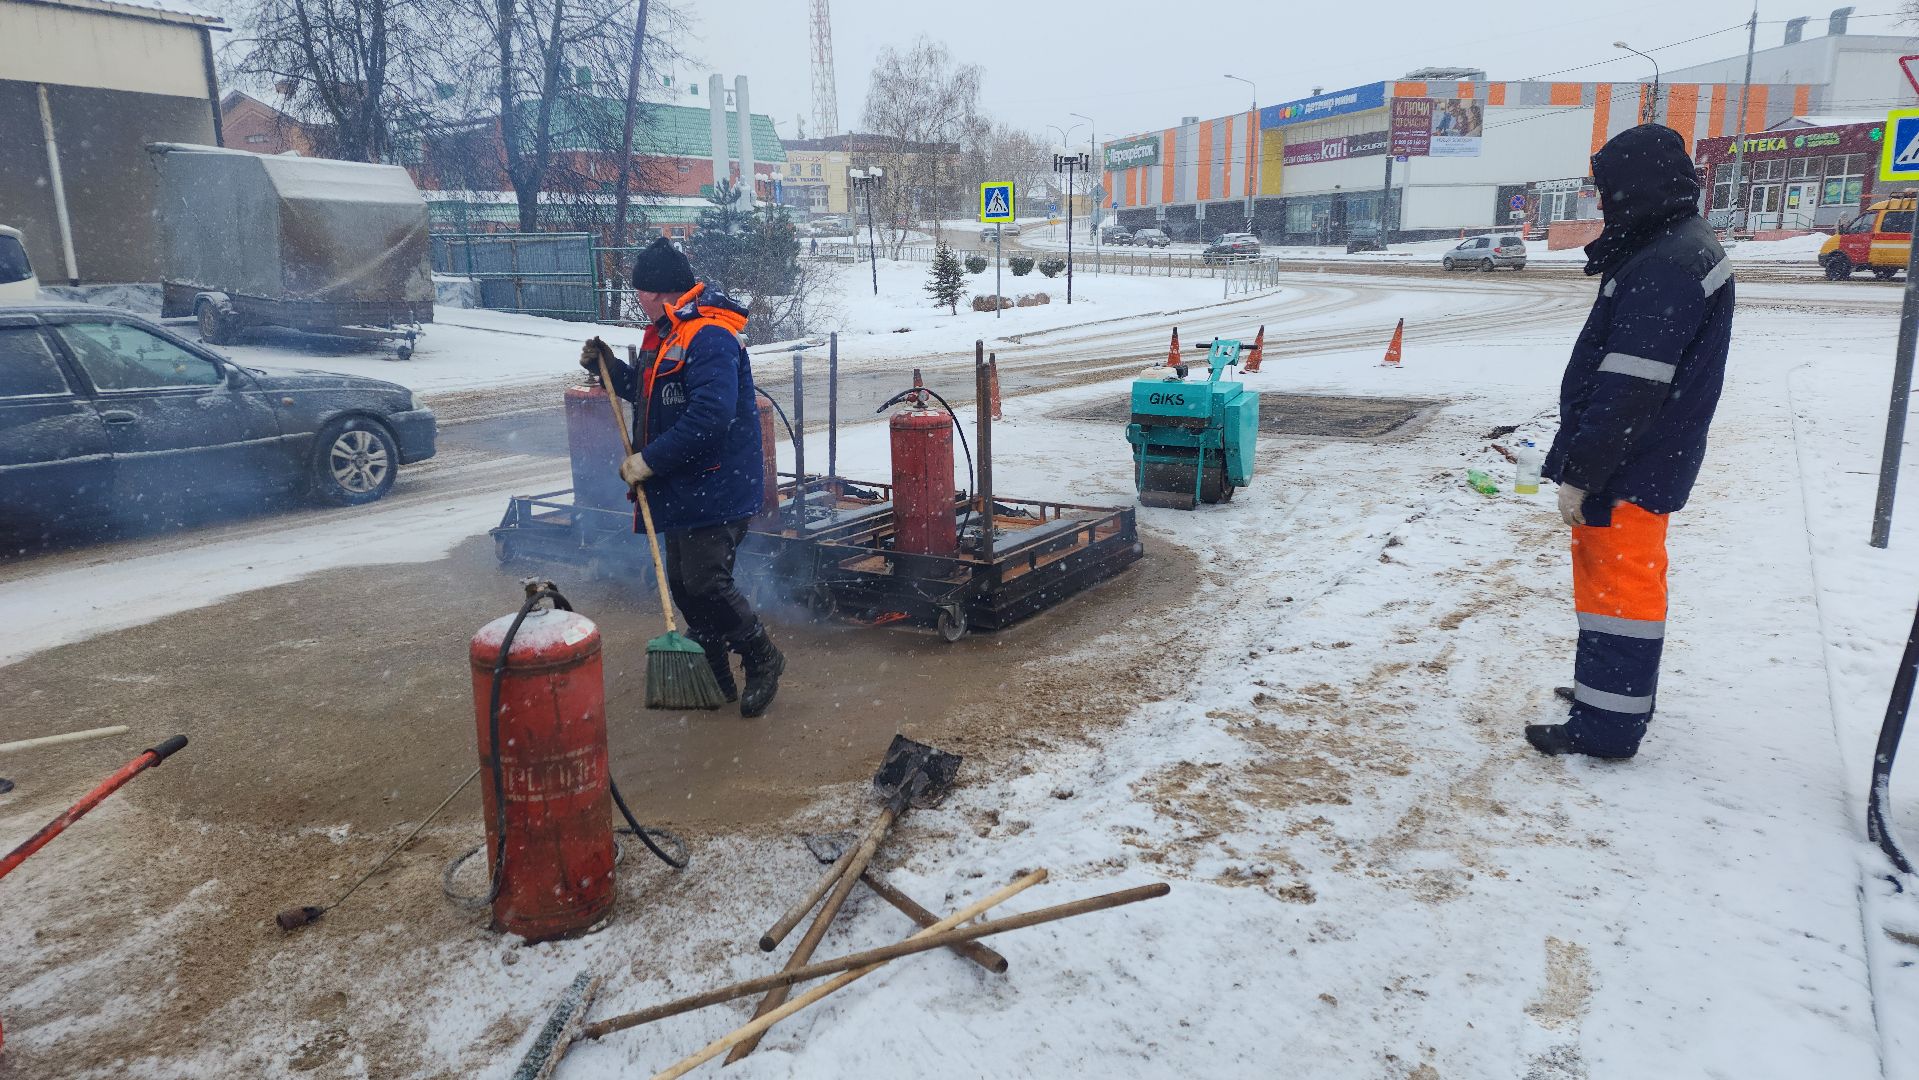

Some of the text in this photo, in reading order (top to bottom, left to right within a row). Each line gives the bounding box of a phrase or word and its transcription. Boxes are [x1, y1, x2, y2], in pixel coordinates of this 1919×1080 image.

[1396, 101, 1430, 116] КЛЮЧИ
[1321, 138, 1348, 159] kari
[1150, 392, 1185, 405] GIKS
